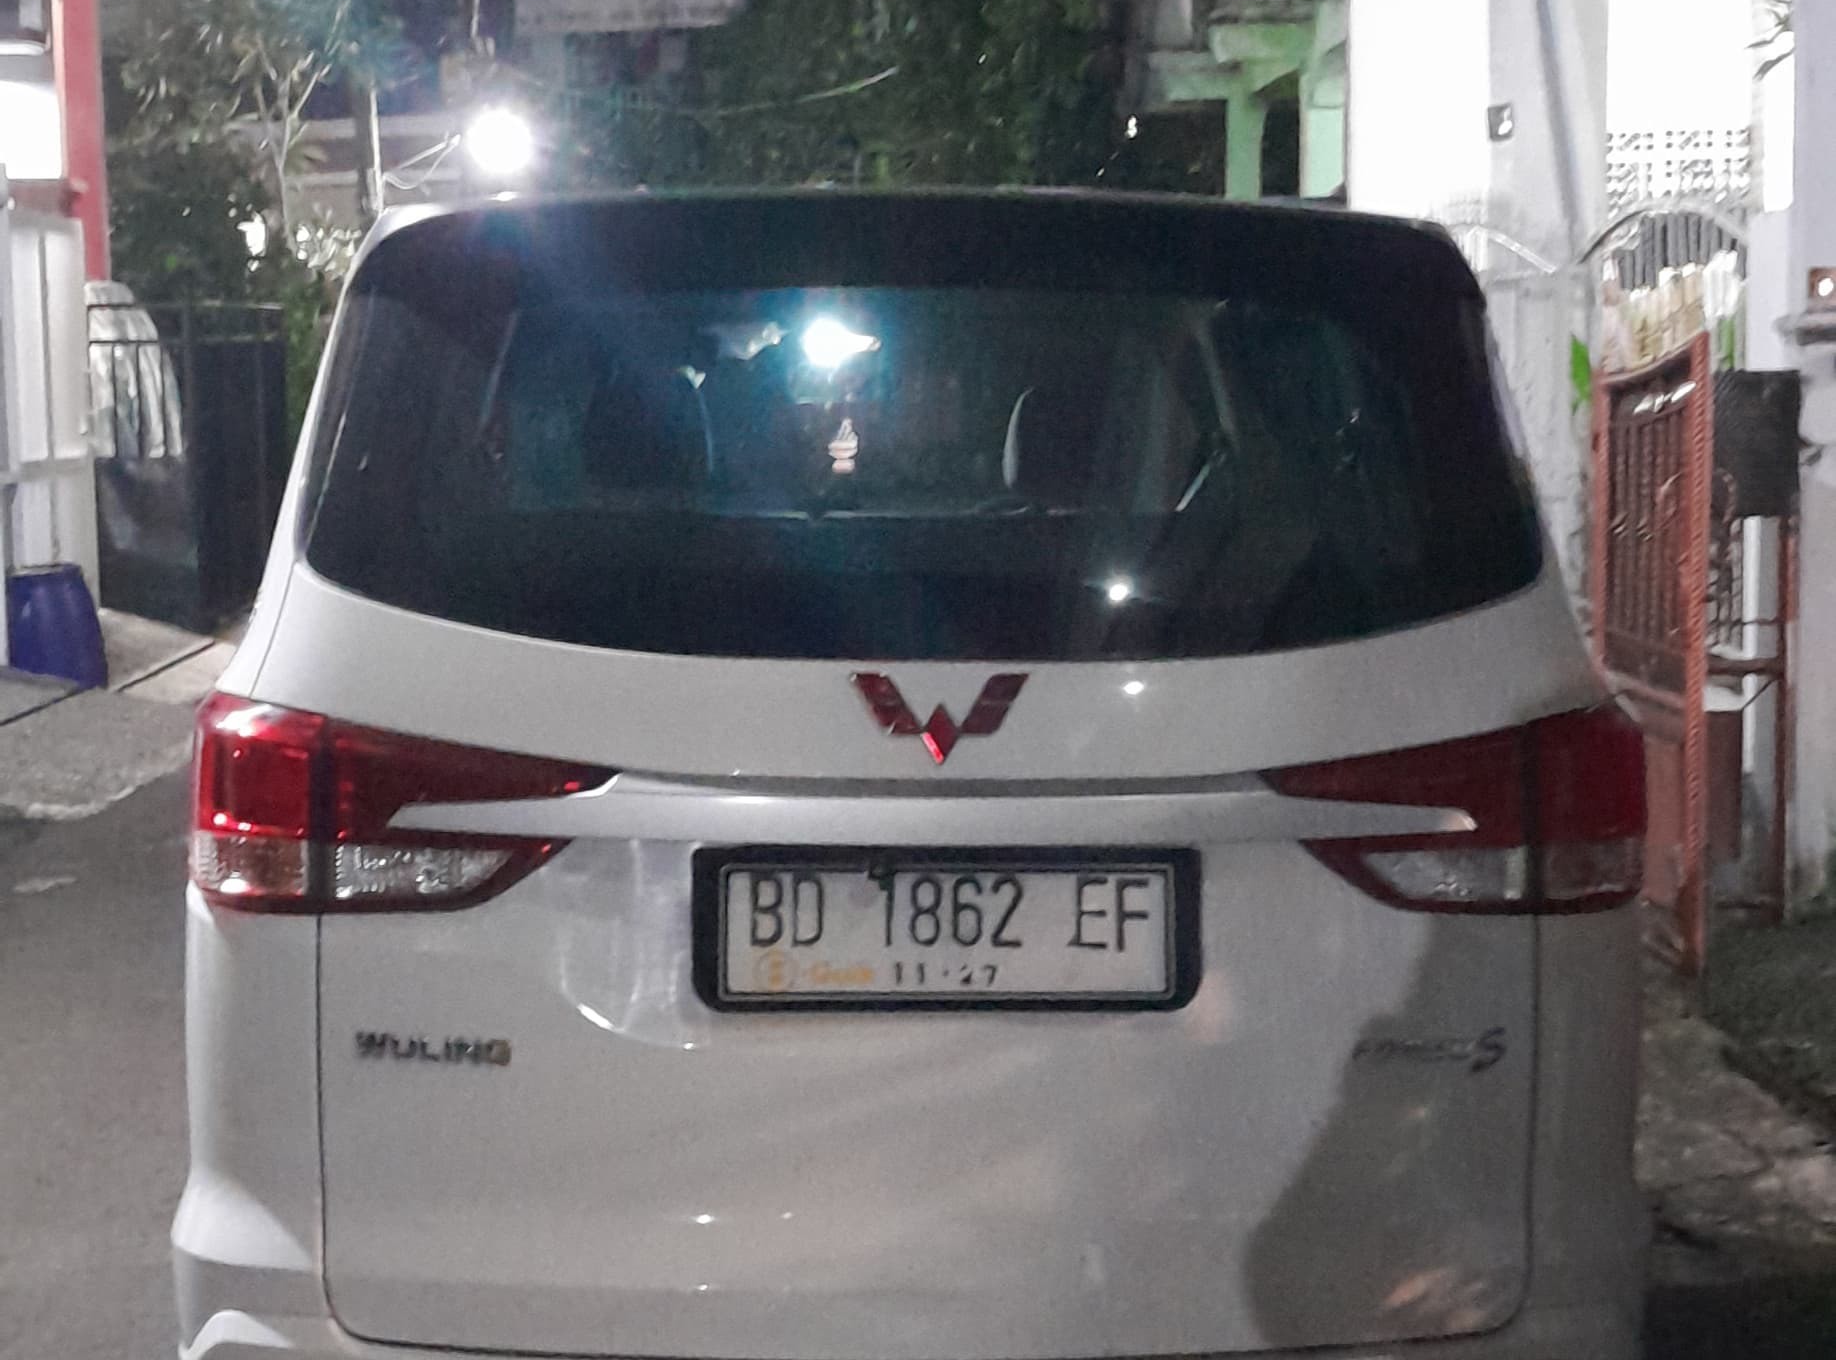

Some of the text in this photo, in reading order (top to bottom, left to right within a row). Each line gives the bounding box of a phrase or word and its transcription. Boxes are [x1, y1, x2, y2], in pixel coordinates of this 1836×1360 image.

[750, 871, 1149, 953] BD 1862 EF
